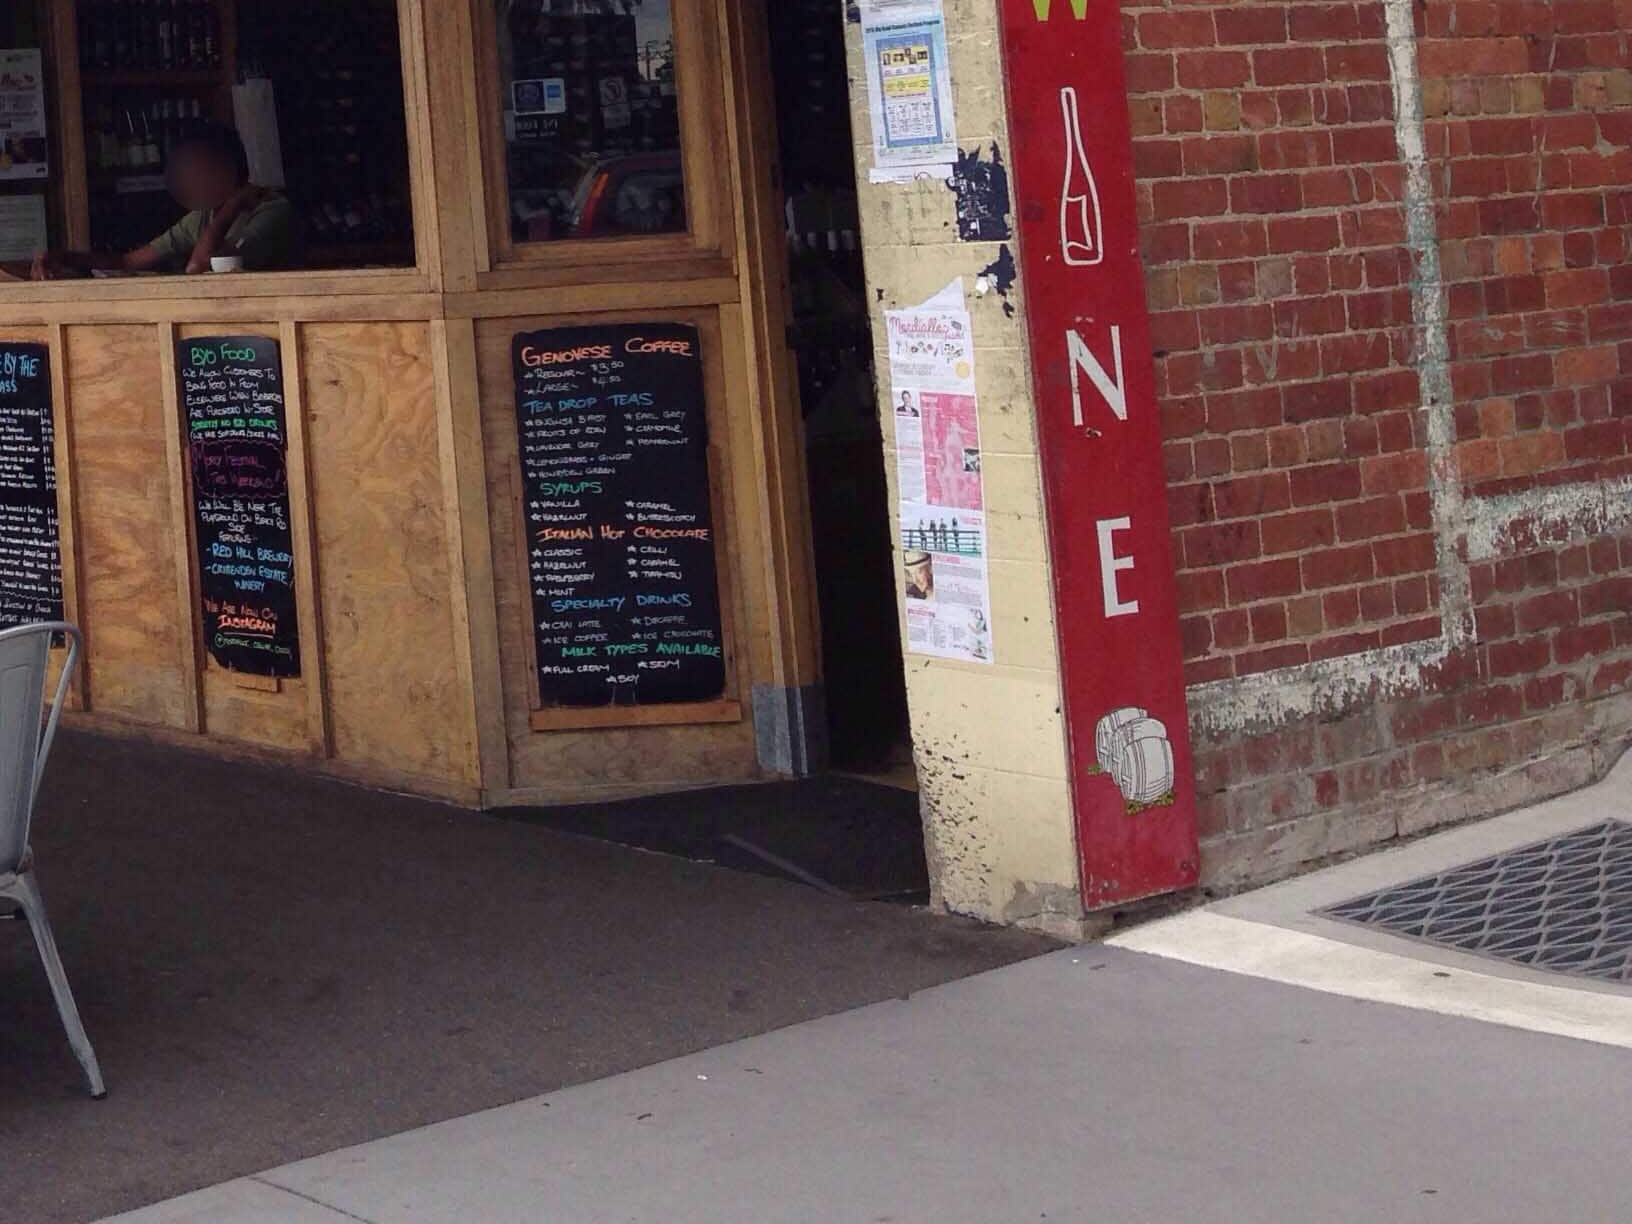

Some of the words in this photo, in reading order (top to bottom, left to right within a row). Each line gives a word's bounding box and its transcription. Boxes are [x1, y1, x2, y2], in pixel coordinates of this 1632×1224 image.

[191, 347, 216, 365] BYO
[221, 343, 256, 362] FOOD
[522, 345, 612, 367] GENOVESE
[625, 337, 693, 356] COFFEE
[4, 352, 16, 380] BY
[19, 355, 40, 377] THE
[522, 400, 553, 415] TEA
[559, 397, 598, 413] DROP
[608, 392, 654, 407] TEAS
[540, 482, 603, 496] SYRUPS
[541, 499, 581, 508] VANILLA
[536, 526, 593, 542] ITALIAN
[601, 525, 625, 539] HOT
[634, 526, 709, 540] CHOCOLATE
[548, 588, 575, 596] MINT
[551, 596, 625, 613] SPECIALTY
[636, 593, 692, 607] DRINKS
[561, 646, 597, 657] MILK
[605, 643, 648, 654] TYPES
[656, 643, 721, 657] AVAILABLE
[618, 674, 640, 684] SOY
